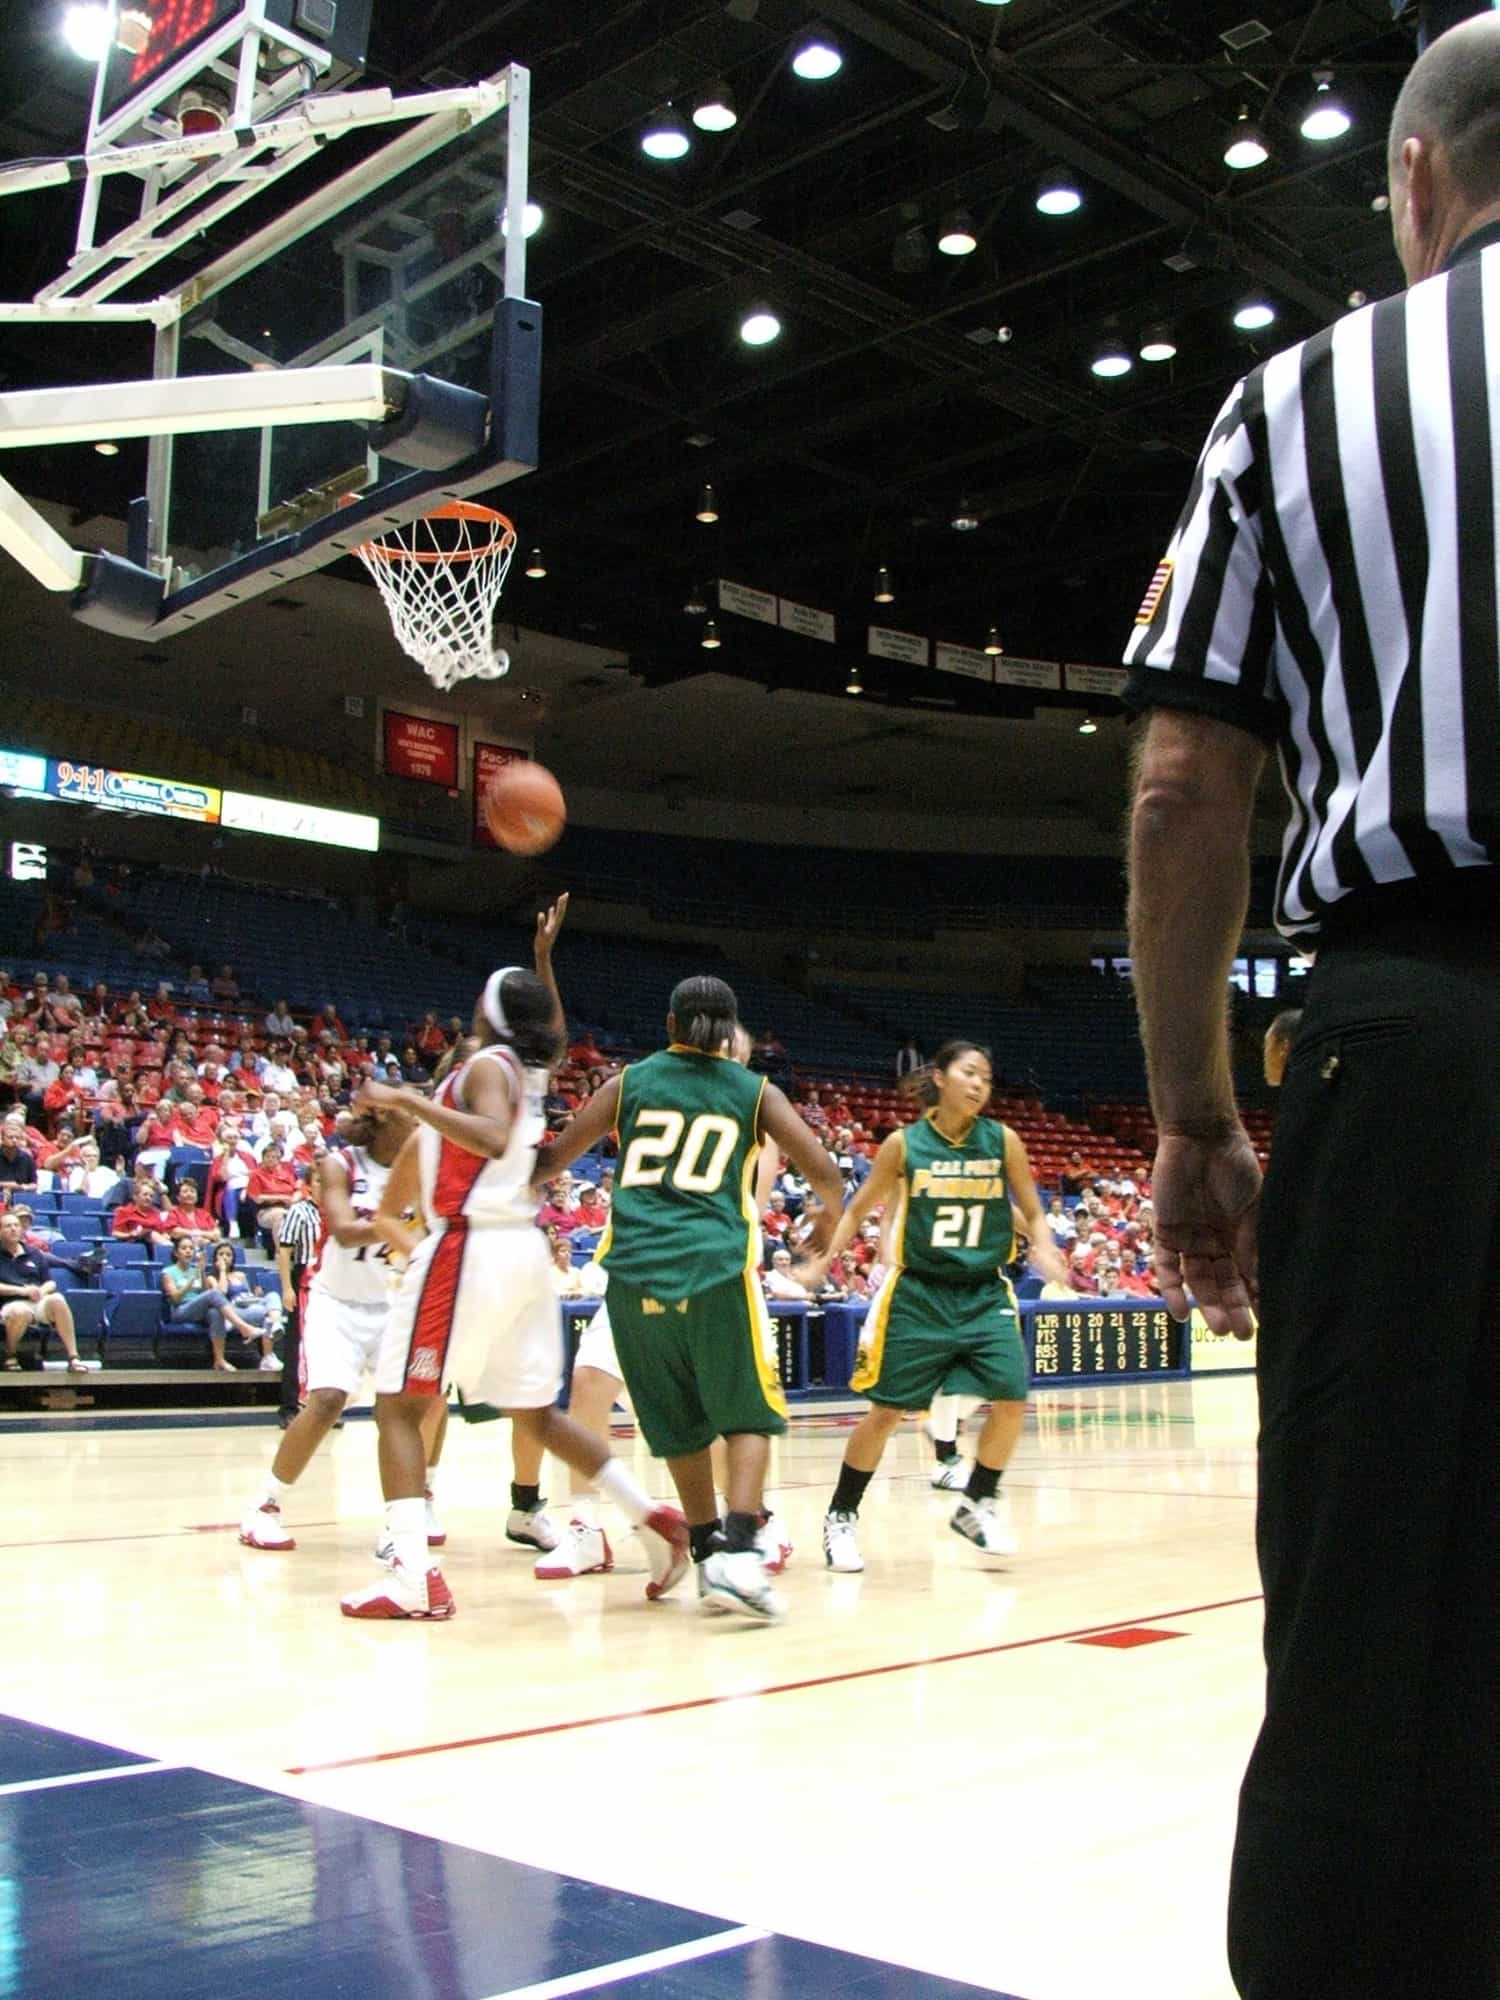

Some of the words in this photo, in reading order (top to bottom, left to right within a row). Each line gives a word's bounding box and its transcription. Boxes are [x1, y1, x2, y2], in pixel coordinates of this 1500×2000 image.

[405, 722, 436, 741] WAC
[620, 1109, 740, 1194] 20
[930, 1204, 985, 1248] 21
[1066, 1314, 1081, 1328] 10
[1087, 1313, 1104, 1328] 20
[1110, 1312, 1124, 1327] 21
[1132, 1312, 1147, 1327] 22
[1153, 1311, 1168, 1326] 42
[1036, 1328, 1056, 1343] PTS
[1072, 1328, 1081, 1342] 2
[1089, 1328, 1102, 1342] 11
[1117, 1327, 1126, 1341] 3
[1138, 1327, 1147, 1340] 6
[1154, 1326, 1168, 1340] 13
[1072, 1343, 1081, 1357] 2
[1095, 1342, 1104, 1355] 4
[1117, 1342, 1126, 1355] 0
[1138, 1341, 1148, 1354] 3
[1035, 1358, 1058, 1374] FLS
[1072, 1358, 1081, 1372] 2
[1095, 1357, 1104, 1371] 2
[1117, 1356, 1126, 1369] 0
[1138, 1355, 1147, 1368] 2
[1160, 1354, 1168, 1367] 2
